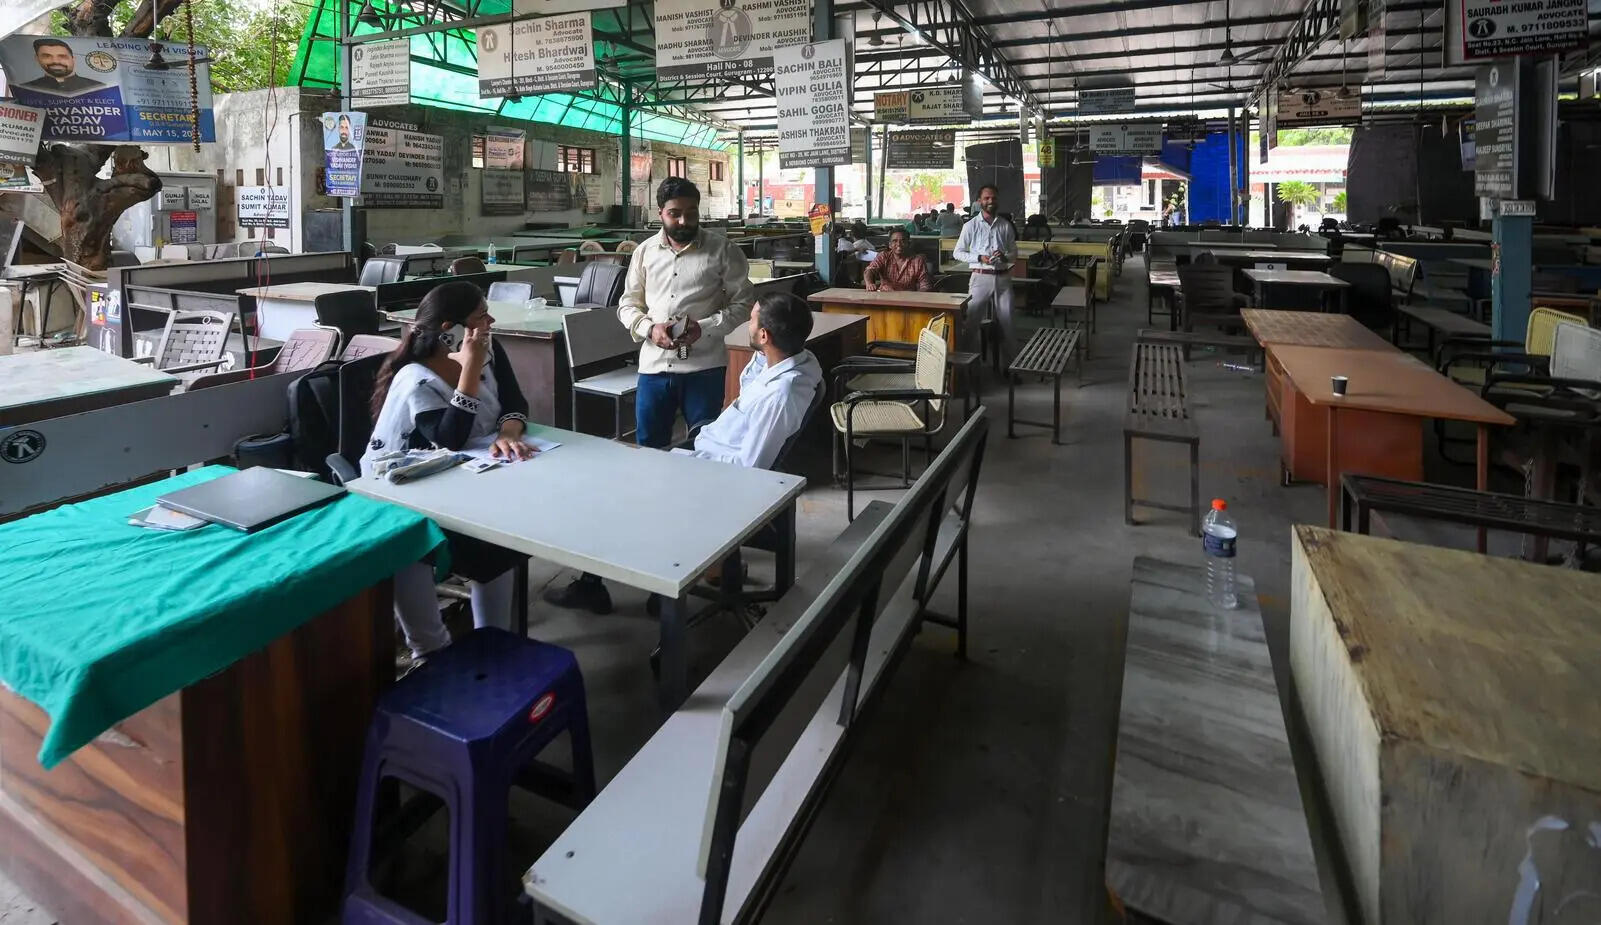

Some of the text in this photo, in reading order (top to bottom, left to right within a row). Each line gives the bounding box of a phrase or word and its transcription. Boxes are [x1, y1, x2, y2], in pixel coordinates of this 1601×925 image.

[742, 3, 772, 12] RASHMI
[776, 6, 807, 14] ADVOCATE
[1468, 6, 1509, 18] SAURABH
[1511, 1, 1543, 13] KUMAR
[656, 9, 714, 22] MANISH VASHIST
[1538, 10, 1583, 21] ADVOCATE
[508, 18, 585, 36] Sachin Sharma
[733, 28, 808, 43] DEVINDER KAUSHIK
[96, 43, 141, 51] LEADING
[684, 38, 714, 47] SHARMA
[504, 43, 588, 63] Htesh Bhardwaj
[707, 62, 723, 71] Hall
[777, 58, 842, 75] SACHIN BALI
[778, 81, 843, 96] VIPIN GULIA
[876, 93, 908, 107] NOTARY
[46, 107, 121, 116] HVANDER
[779, 104, 844, 118] SAHIL GOGIA
[50, 116, 101, 125] YADAV
[140, 112, 195, 122] SECRETAR
[1, 123, 35, 132] KUMAR
[372, 119, 418, 131] ADVOCATES
[51, 126, 105, 136] (VISHU)
[781, 126, 846, 140] ASHISH THAKRAN
